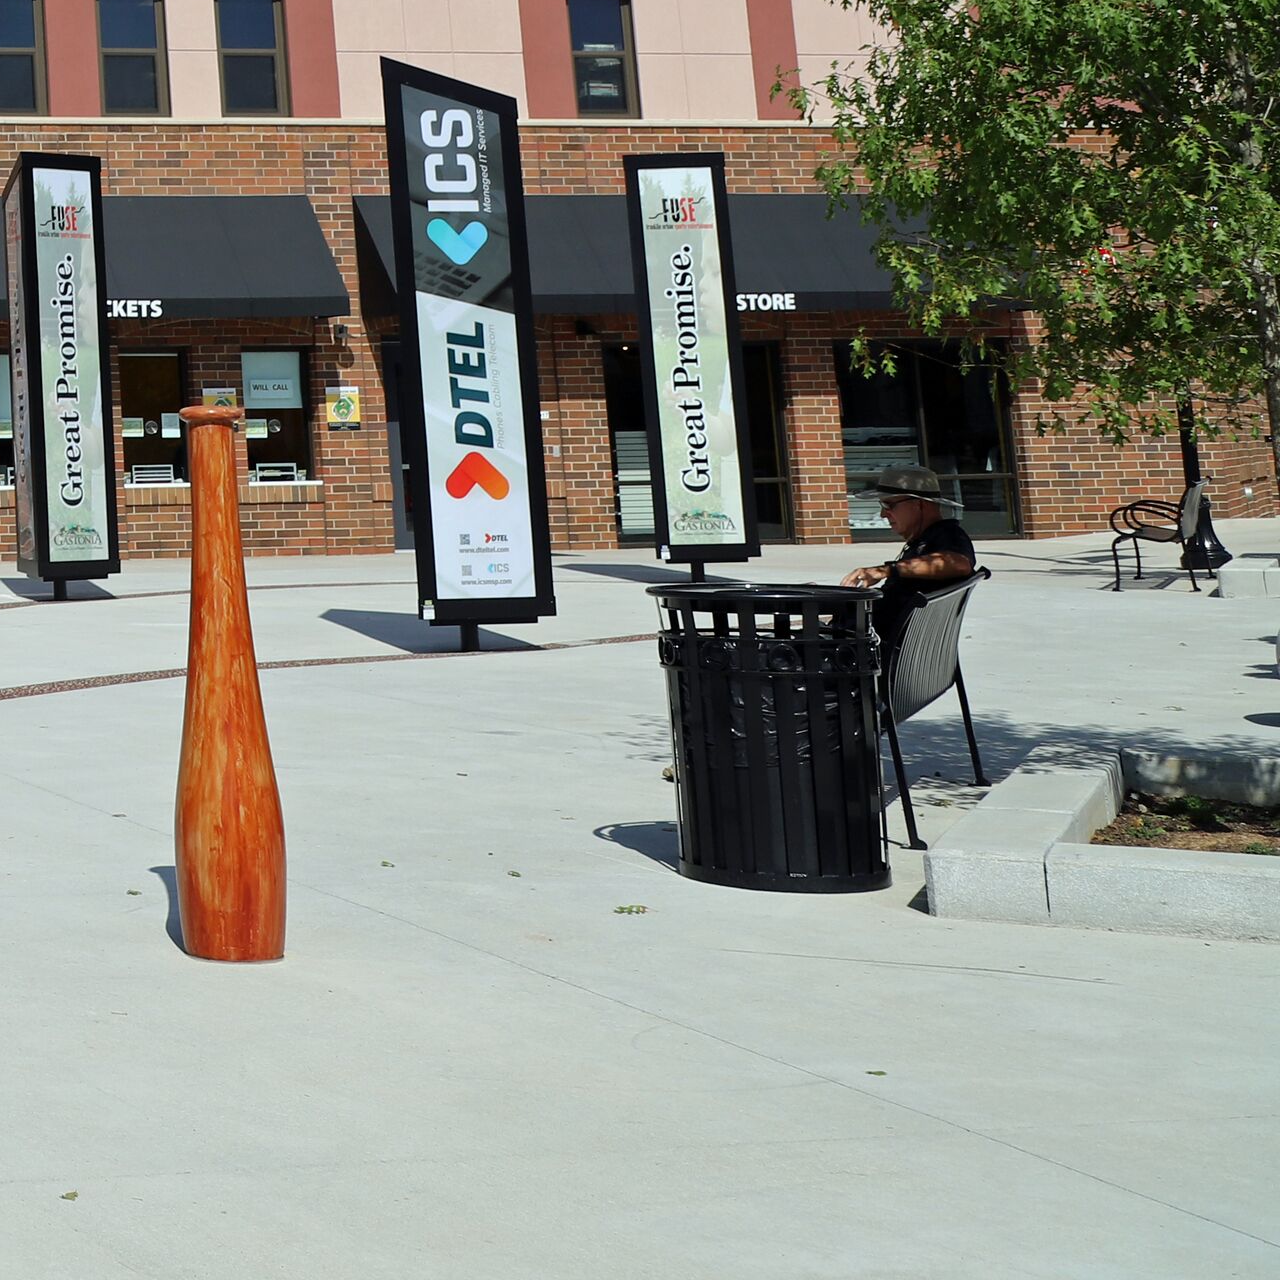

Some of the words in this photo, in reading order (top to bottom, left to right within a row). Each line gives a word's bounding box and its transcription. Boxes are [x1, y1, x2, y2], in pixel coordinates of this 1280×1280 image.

[476, 109, 487, 151] Services
[420, 109, 480, 212] ICS
[478, 153, 488, 163] IT
[481, 165, 492, 213] Managed
[51, 206, 77, 231] FUSE
[662, 198, 696, 222] FUSE
[107, 300, 163, 318] KETS
[666, 246, 700, 391] Promise.
[736, 293, 796, 311] STORE
[52, 255, 78, 402] Promise.
[489, 324, 498, 365] Telecom
[446, 321, 494, 448] DTEL
[492, 369, 501, 408] Cabling
[496, 413, 505, 449] Phones
[679, 399, 710, 492] Great
[60, 411, 83, 507] Great
[53, 532, 102, 546] GASTONIA
[674, 518, 736, 531] GASTONIA
[494, 564, 509, 572] ICS
